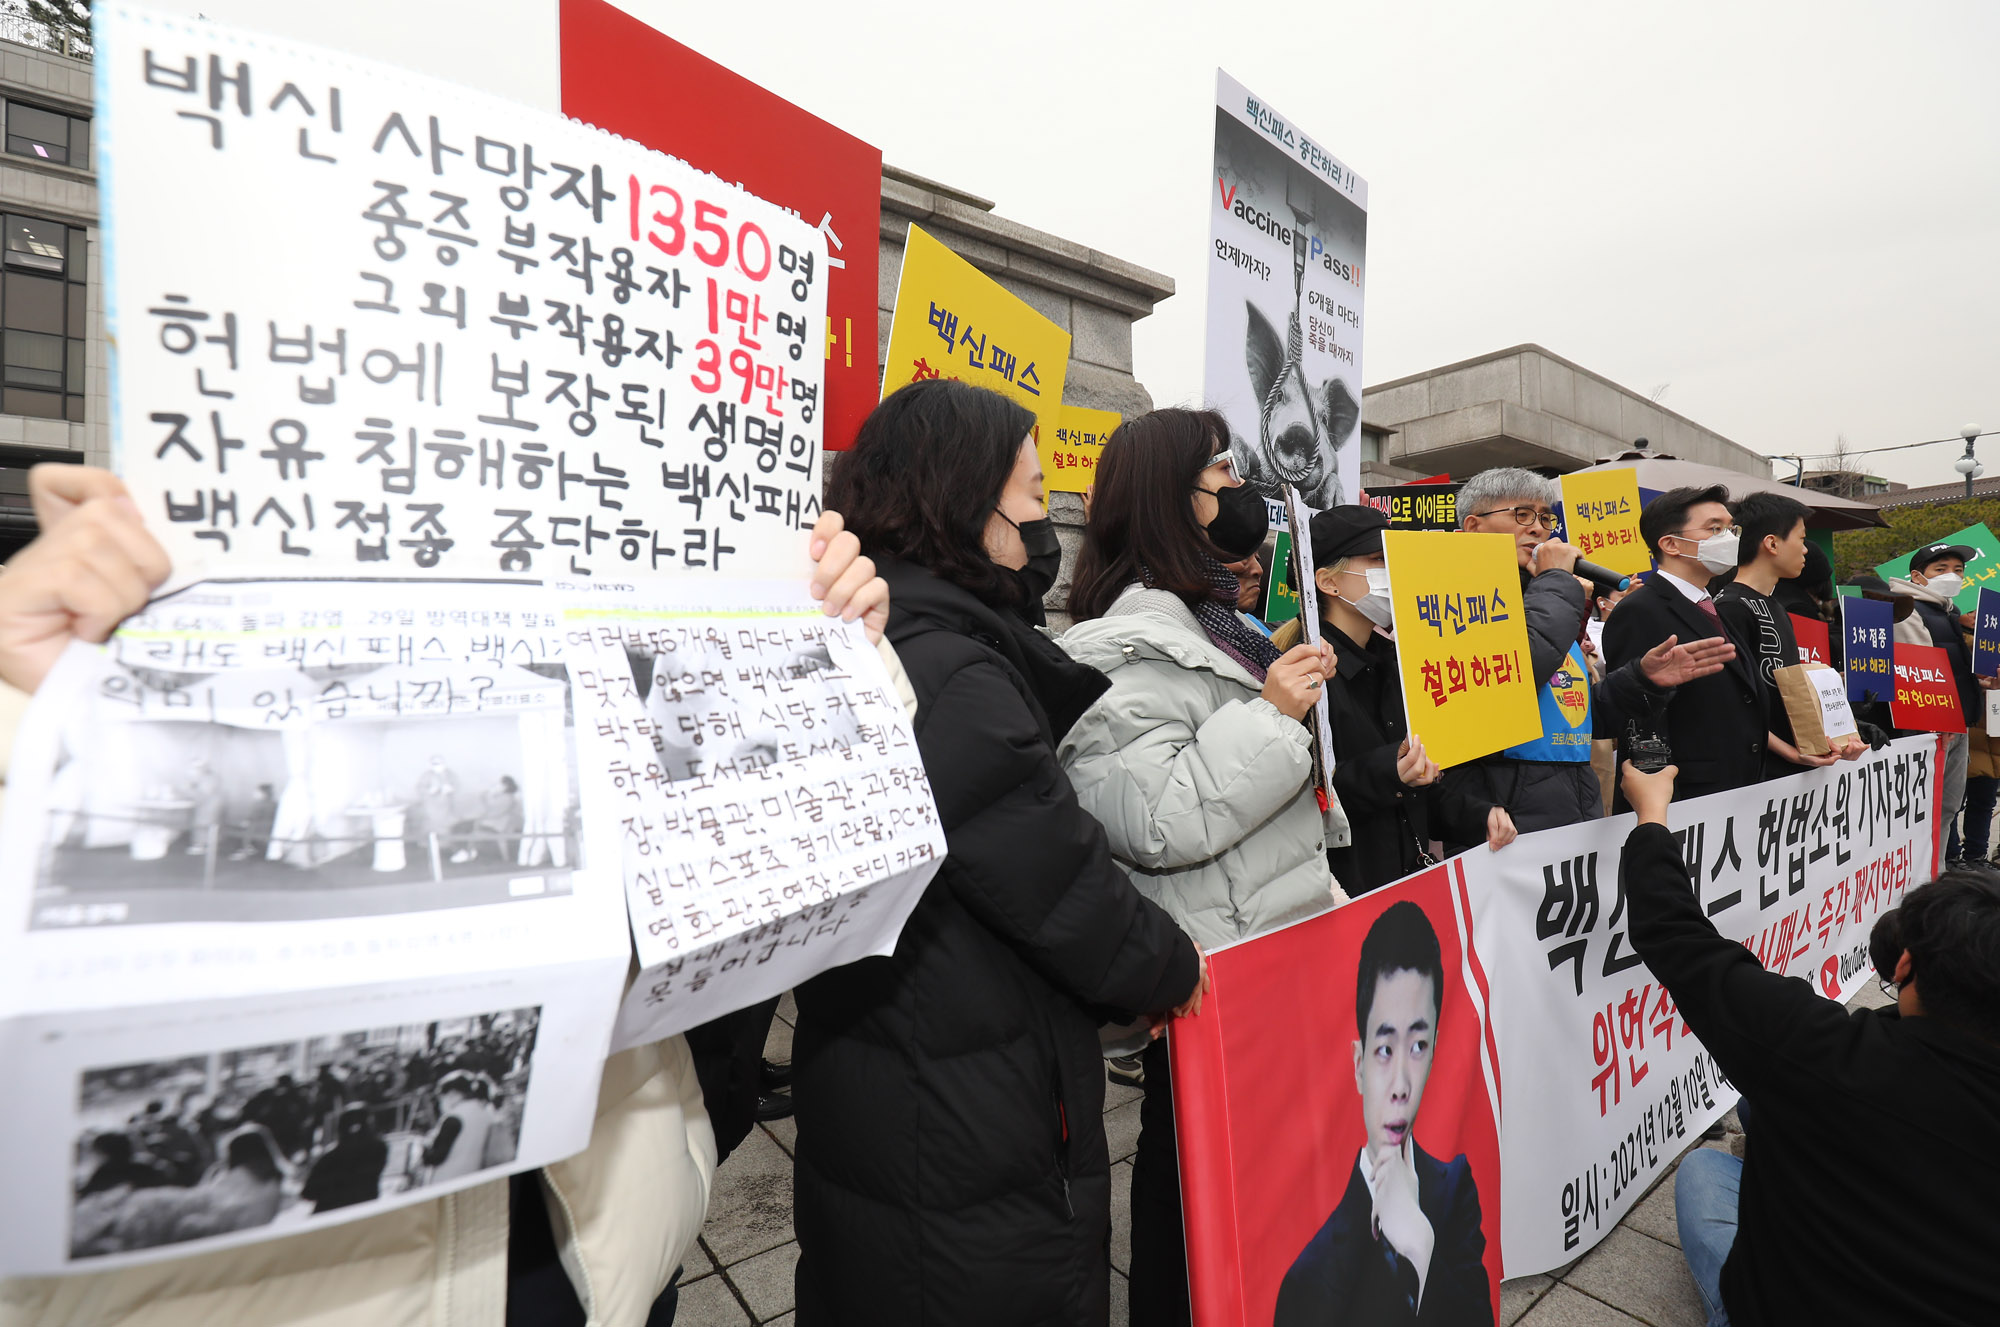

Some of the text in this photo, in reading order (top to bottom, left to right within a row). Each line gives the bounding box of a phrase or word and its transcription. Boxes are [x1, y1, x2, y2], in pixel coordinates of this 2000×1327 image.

[1245, 96, 1296, 150] 백신패스
[1299, 136, 1342, 185] 중단하라
[142, 47, 341, 166] 백신
[372, 111, 616, 224] 사망자
[627, 174, 772, 282] 1350
[777, 242, 813, 301] 명
[1218, 176, 1292, 246] Vaccine
[360, 180, 478, 268] 중증
[496, 214, 691, 309] 부작용자
[705, 276, 769, 350] 1만
[777, 311, 807, 361] 명
[1214, 238, 1272, 282] 언제까지?
[1308, 290, 1359, 329] 6개월 마다!
[1308, 315, 1336, 341] 당신이
[489, 292, 683, 369] 부작용자
[689, 338, 788, 418] 39만
[791, 379, 818, 426] 명
[928, 300, 1041, 397] 백신패스
[1328, 342, 1355, 367] 때까지
[148, 294, 816, 481] 헌법에 보장된 생명의
[1056, 428, 1109, 446] 백신패스
[150, 409, 822, 531] 자유 침해하는 백신패스
[164, 489, 735, 575] 백신접종 중단하라
[1369, 493, 1456, 524] 백신으로 아이들을
[1576, 496, 1631, 523] 백신패스
[1578, 526, 1638, 555] 철회하라!
[1416, 587, 1509, 637] 백신패스
[802, 624, 852, 650] 백신
[1852, 626, 1887, 649] 3차 접종
[1420, 649, 1522, 707] 철회하라!
[1850, 658, 1867, 673] 너나
[1893, 664, 1947, 683] 백신패스
[1897, 688, 1955, 709] 위헌이다!
[677, 711, 746, 746] 당해
[1756, 782, 1852, 910] 헌법소원
[1857, 750, 1928, 847] 기자회견
[1591, 839, 1913, 1118] 위헌적 신패스 즉각 폐지하라!
[1611, 1104, 1658, 1200] 2021년
[1656, 1076, 1687, 1141] 12월
[1683, 1052, 1716, 1115] 10일
